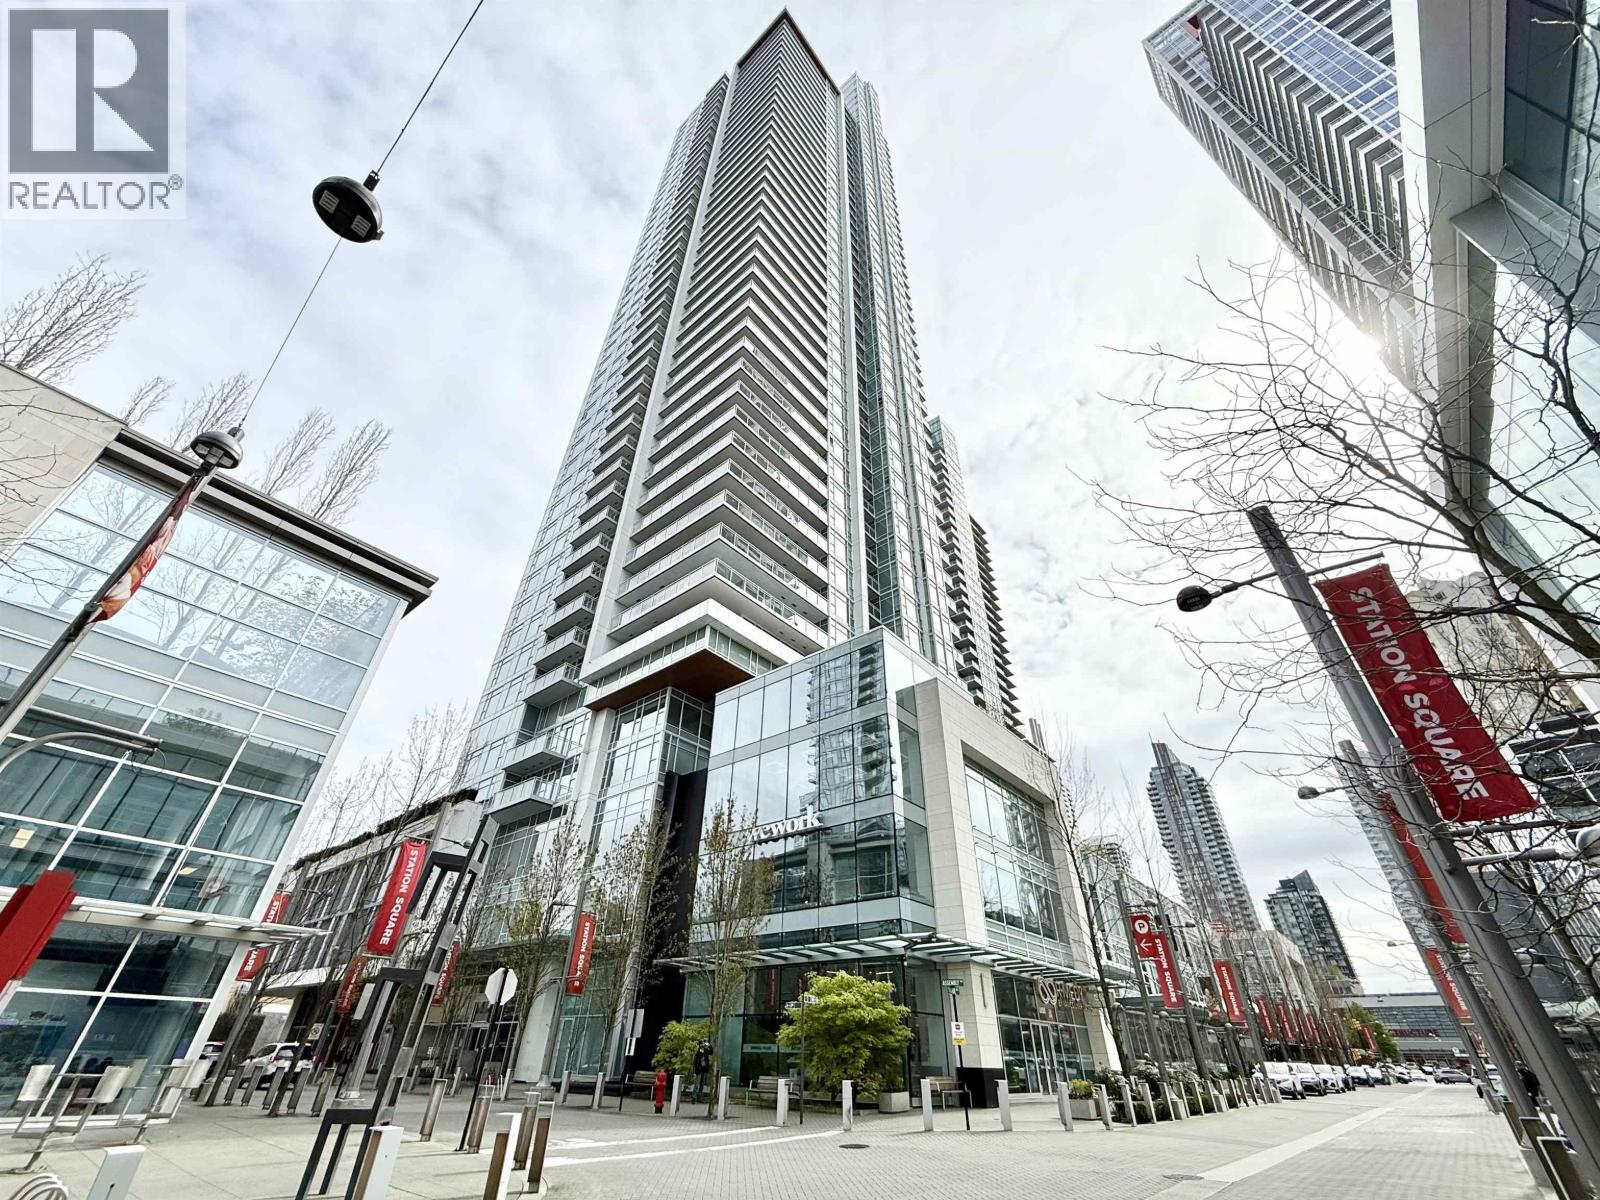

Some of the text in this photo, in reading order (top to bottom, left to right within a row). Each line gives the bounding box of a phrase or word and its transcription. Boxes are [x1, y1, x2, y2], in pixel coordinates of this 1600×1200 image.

[1350, 586, 1490, 801] STATION SQUARE
[379, 848, 419, 946] STATION SQUARE
[1137, 922, 1145, 931] P
[243, 900, 280, 972] STATI ARE
[574, 921, 591, 987] STATION SQUAE
[1155, 938, 1178, 1003] STATION SQUARE
